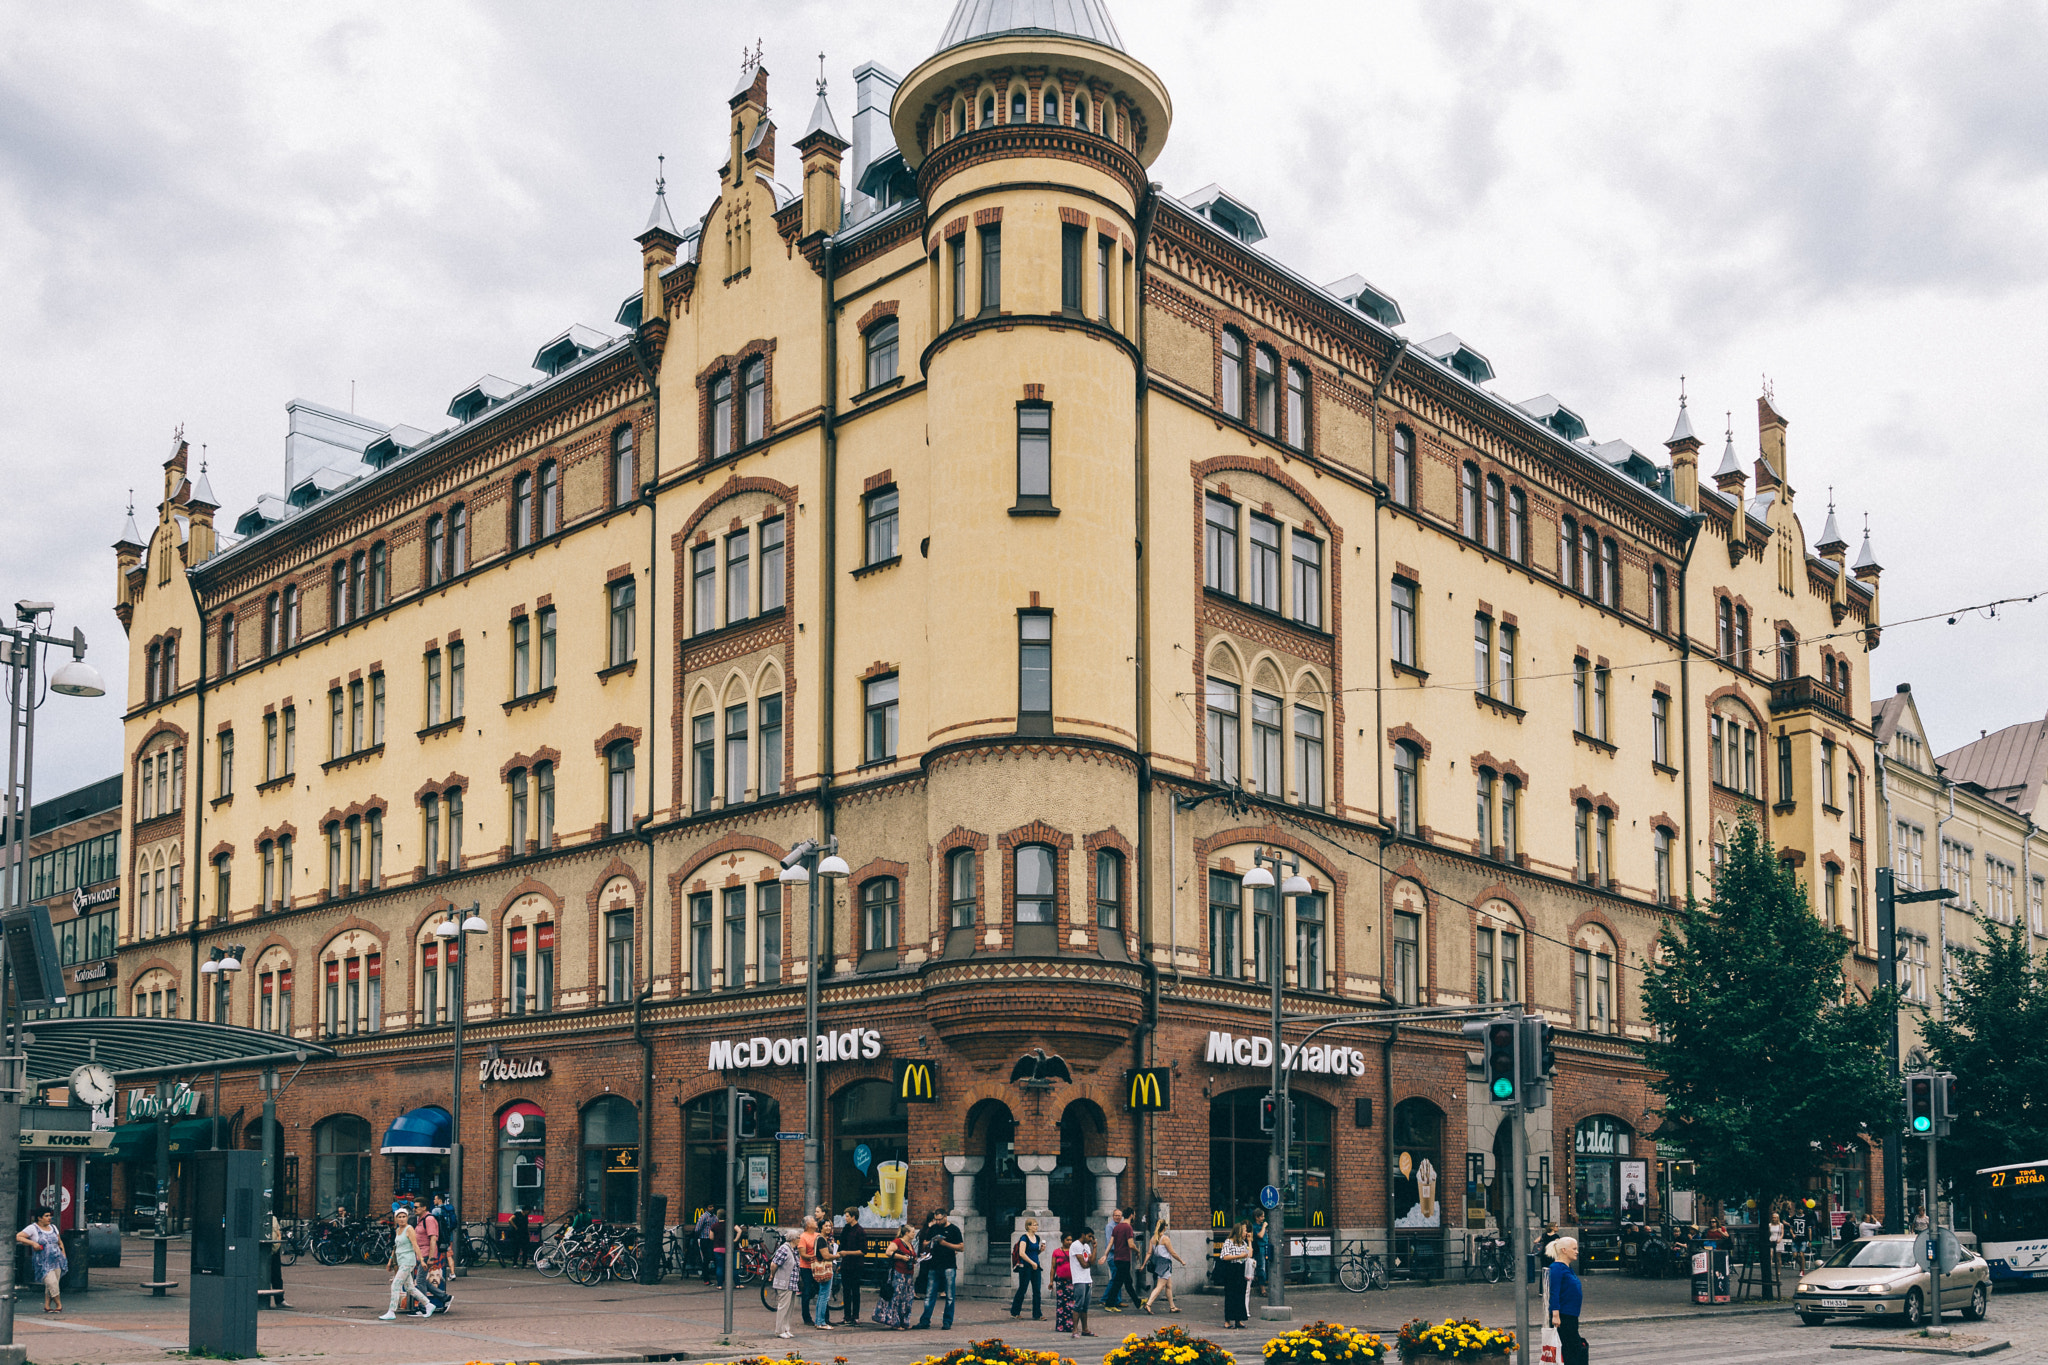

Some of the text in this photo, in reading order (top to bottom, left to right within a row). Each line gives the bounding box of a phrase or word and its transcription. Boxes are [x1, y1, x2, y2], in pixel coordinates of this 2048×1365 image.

[708, 1027, 881, 1071] McDonald's
[1205, 1030, 1366, 1077] McDonald's
[48, 1135, 92, 1145] KIOSK
[1991, 1172, 2006, 1187] 27
[2015, 1174, 2046, 1185] IRJALA
